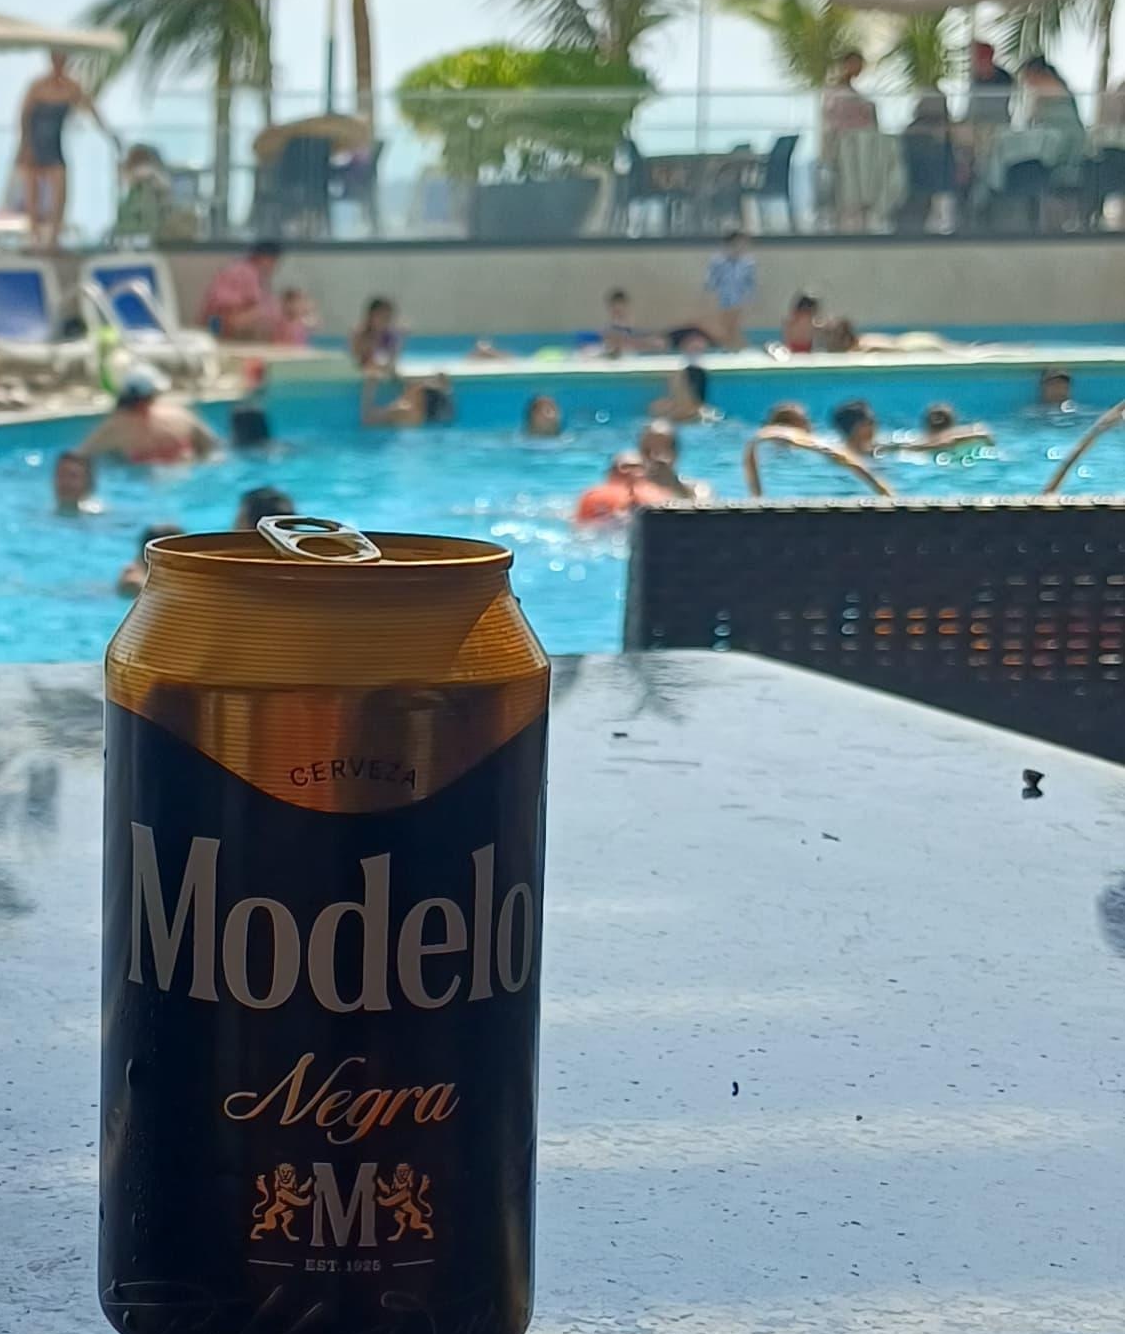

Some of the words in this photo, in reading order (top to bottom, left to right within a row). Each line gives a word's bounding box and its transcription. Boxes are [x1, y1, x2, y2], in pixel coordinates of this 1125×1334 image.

[289, 758, 418, 789] CERVEZA
[127, 821, 535, 1013] Modelo
[223, 1052, 459, 1145] Negra
[310, 1162, 379, 1248] M
[304, 1258, 342, 1273] EST.
